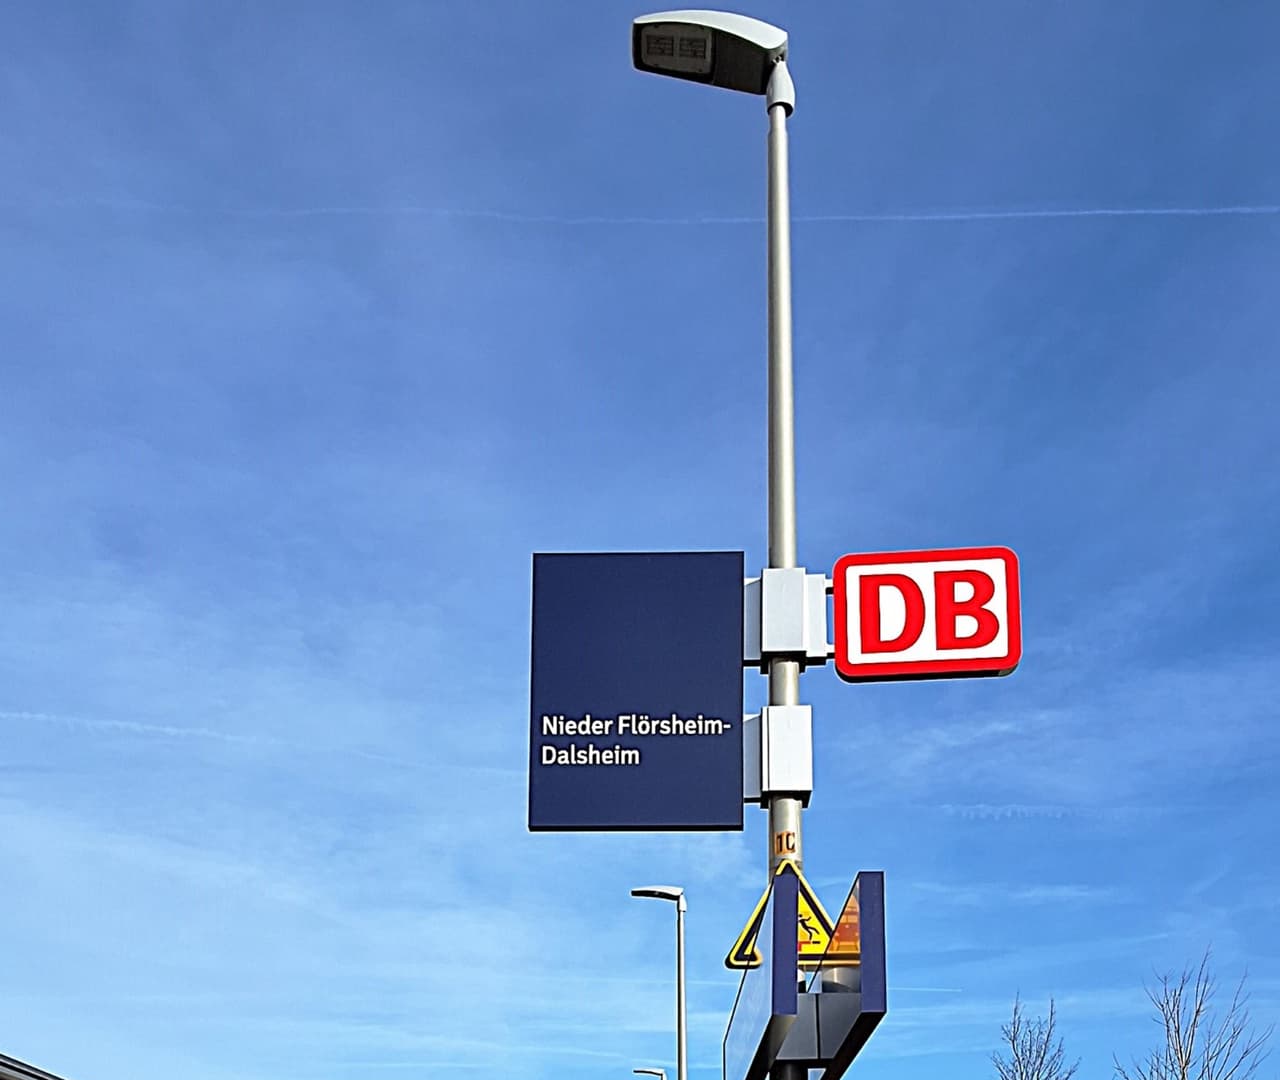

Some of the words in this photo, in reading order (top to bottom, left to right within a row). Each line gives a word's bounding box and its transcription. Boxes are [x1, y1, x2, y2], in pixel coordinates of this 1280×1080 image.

[859, 569, 1000, 655] DB
[542, 714, 614, 735] Nieder
[618, 713, 732, 735] Flörsheim-
[541, 743, 640, 765] Dalsheim
